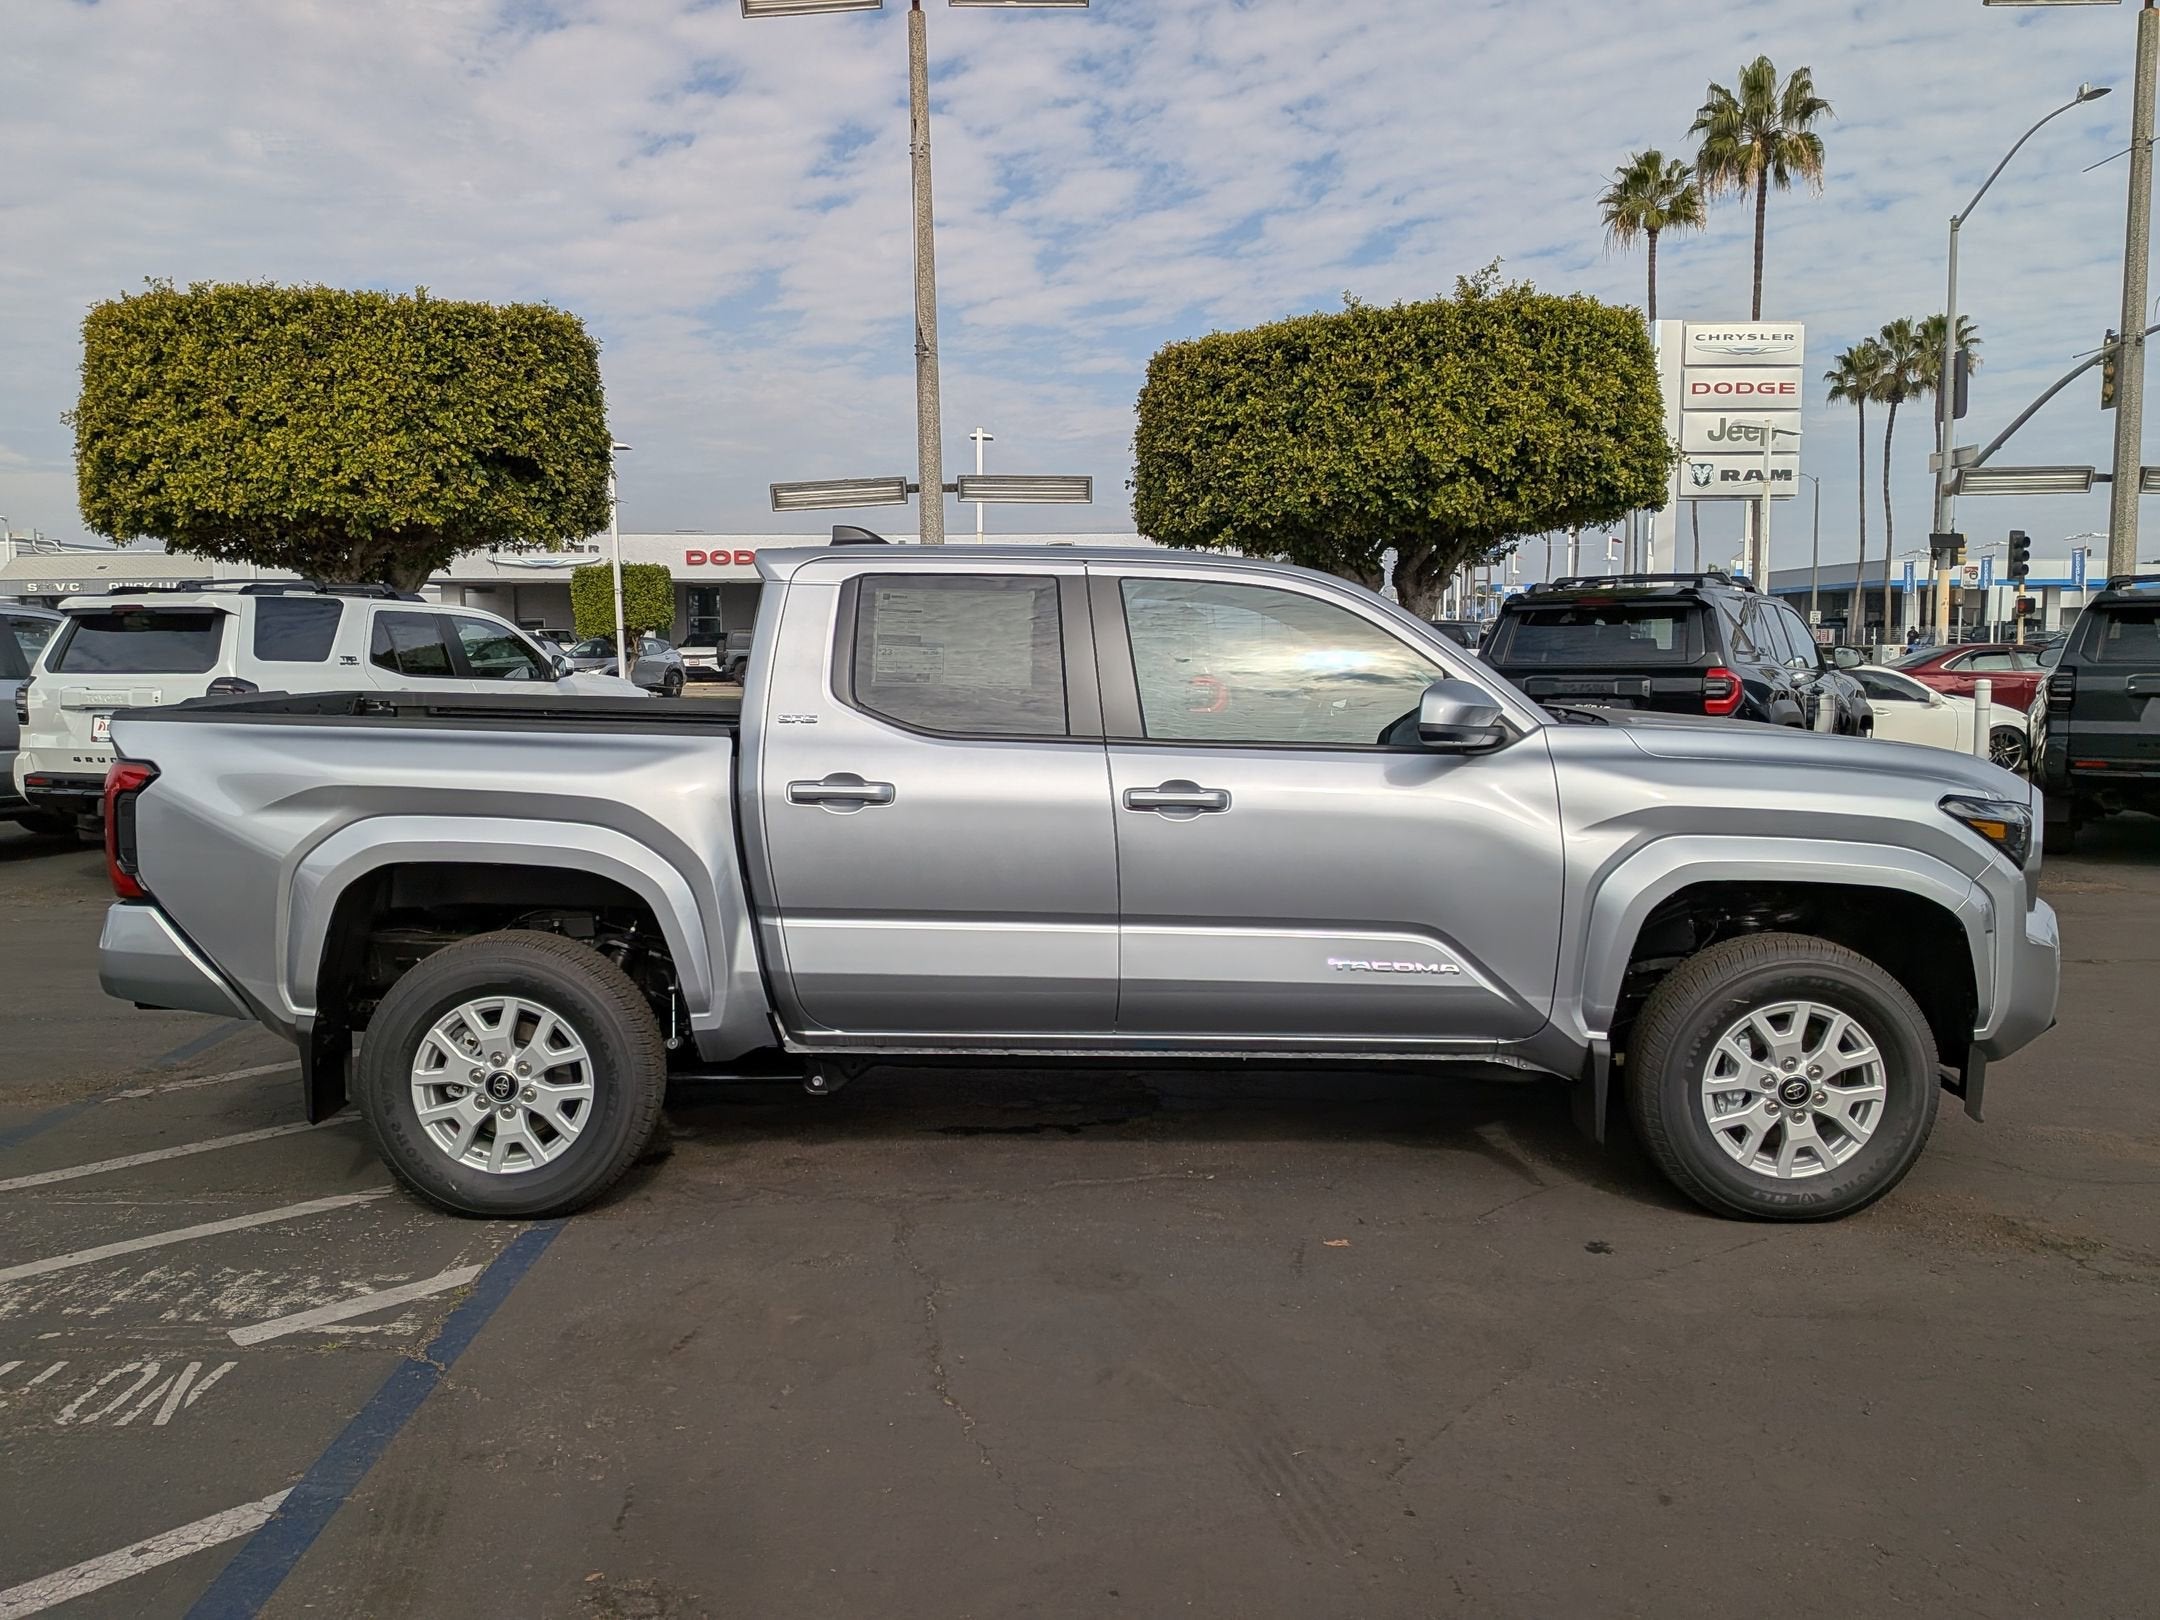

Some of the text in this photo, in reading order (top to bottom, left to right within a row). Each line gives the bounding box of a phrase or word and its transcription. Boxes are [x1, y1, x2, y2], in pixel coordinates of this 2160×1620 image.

[1695, 333, 1795, 342] CHRYSLER
[1691, 382, 1796, 395] DODGE
[1720, 469, 1793, 482] RAM
[86, 694, 124, 703] TOYOTA
[777, 714, 818, 724] SR5
[1328, 958, 1461, 975] TACOMA
